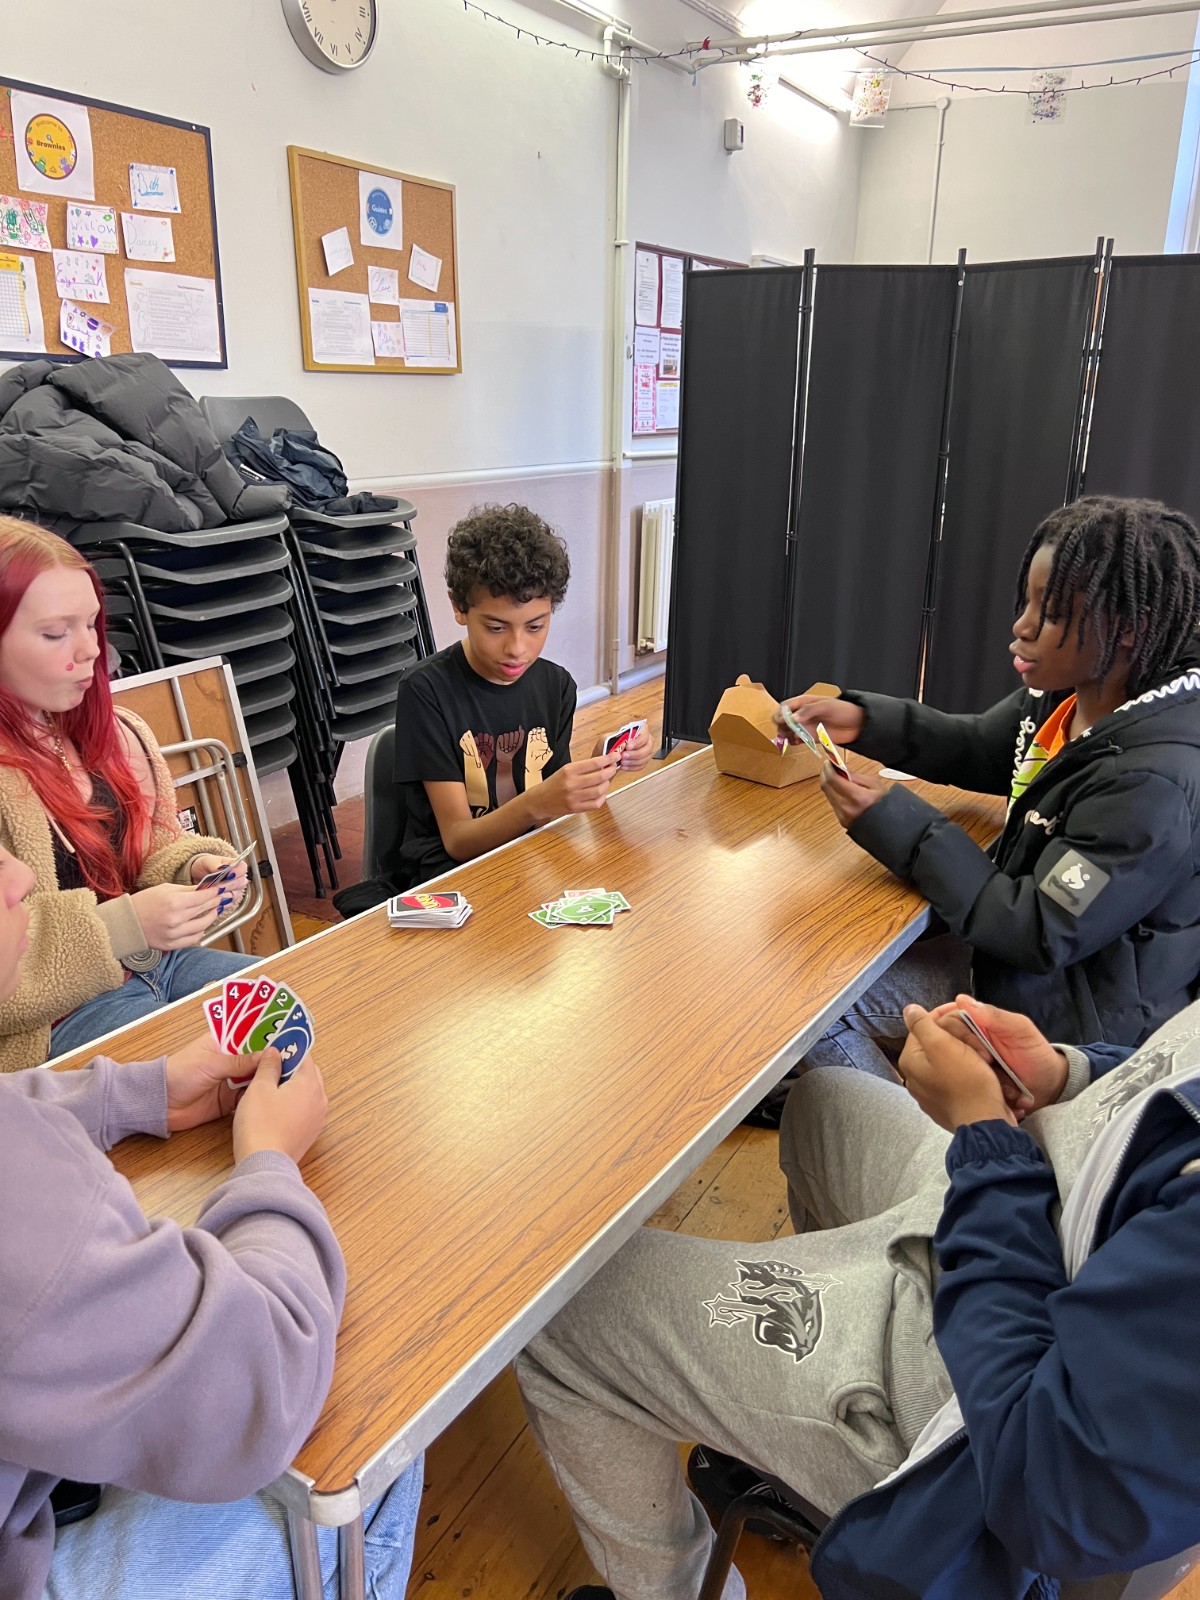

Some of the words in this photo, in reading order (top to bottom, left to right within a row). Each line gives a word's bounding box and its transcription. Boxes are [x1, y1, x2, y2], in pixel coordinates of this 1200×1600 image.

[302, 1, 313, 23] VIII
[314, 26, 324, 46] VII
[354, 27, 363, 42] IV
[329, 42, 338, 57] VI
[345, 42, 352, 55] V
[36, 140, 66, 151] Brownies
[371, 204, 388, 214] Guides
[228, 985, 240, 1000] 4
[257, 984, 271, 999] 3
[276, 992, 288, 1007] 2
[211, 1004, 223, 1019] 3
